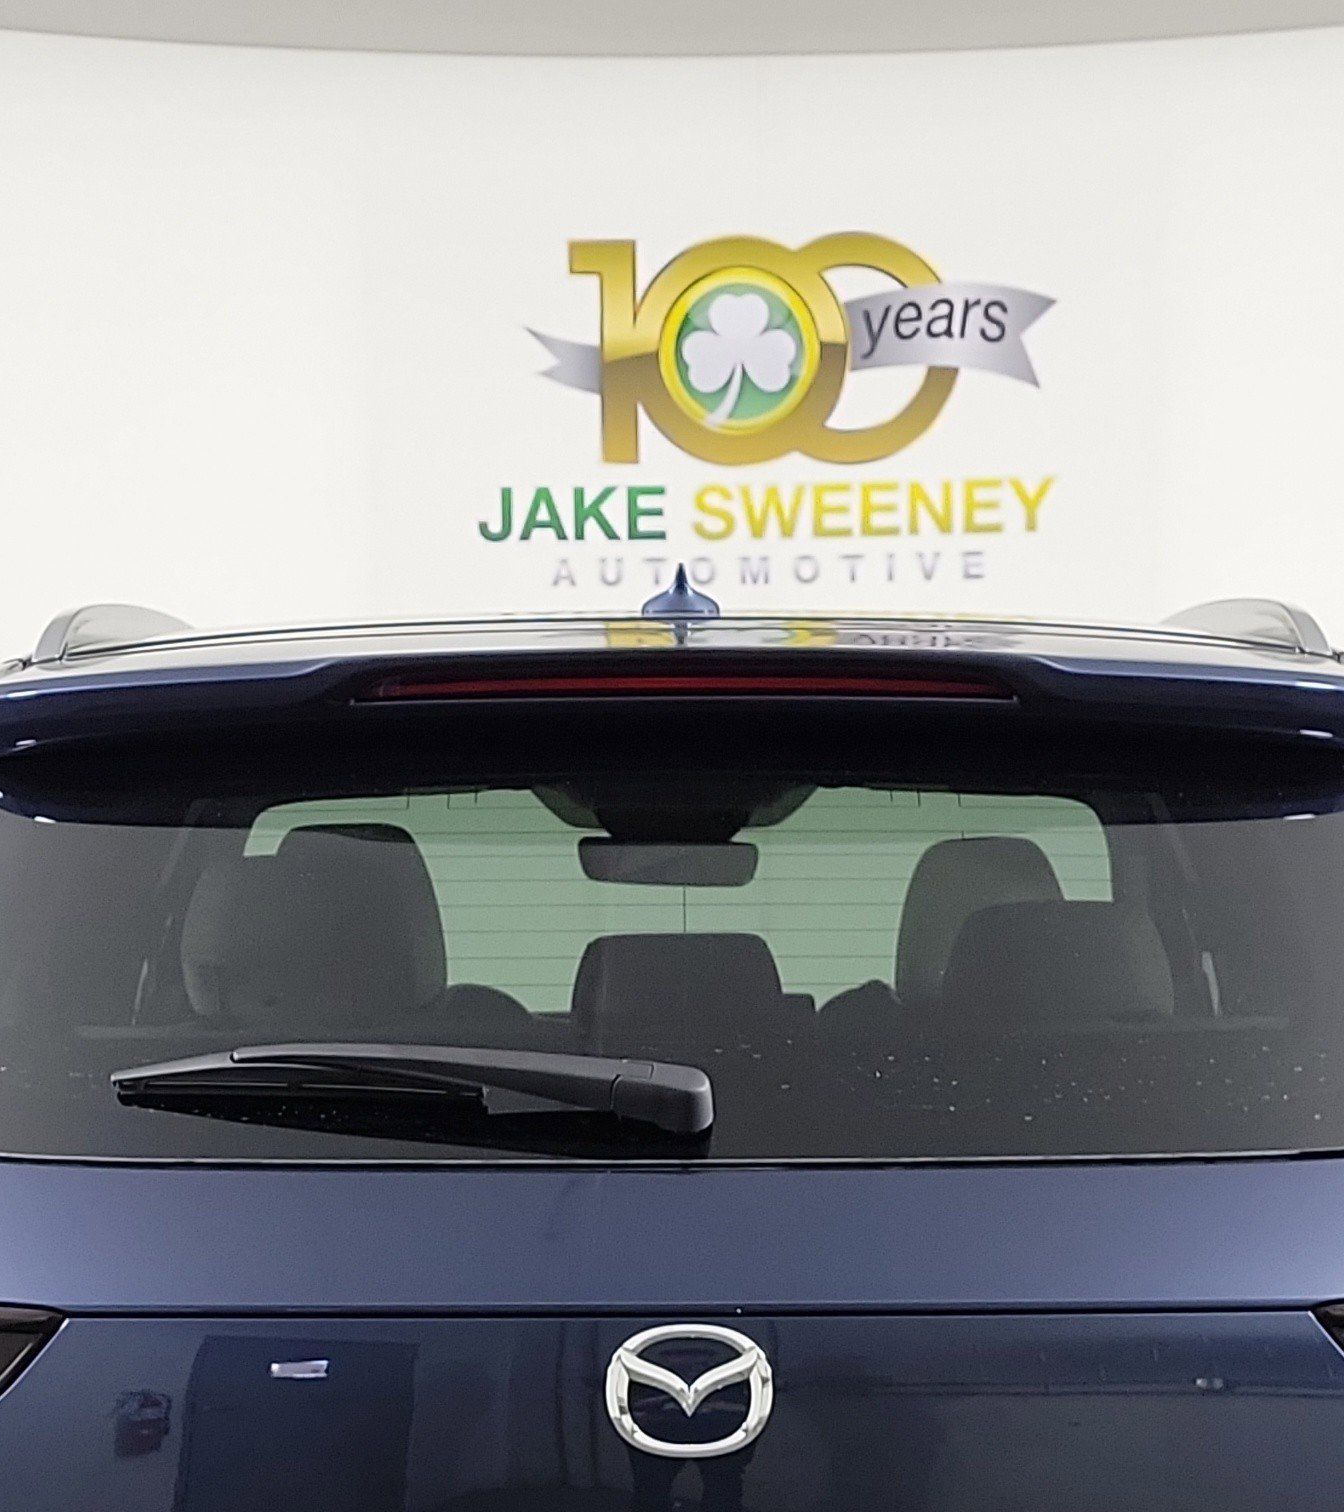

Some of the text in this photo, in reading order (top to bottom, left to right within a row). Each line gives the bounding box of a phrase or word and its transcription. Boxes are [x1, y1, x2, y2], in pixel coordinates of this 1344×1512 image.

[860, 297, 1010, 361] years
[478, 476, 1056, 543] JAKE SWEENEY
[552, 550, 987, 589] AUTOMOTIVE
